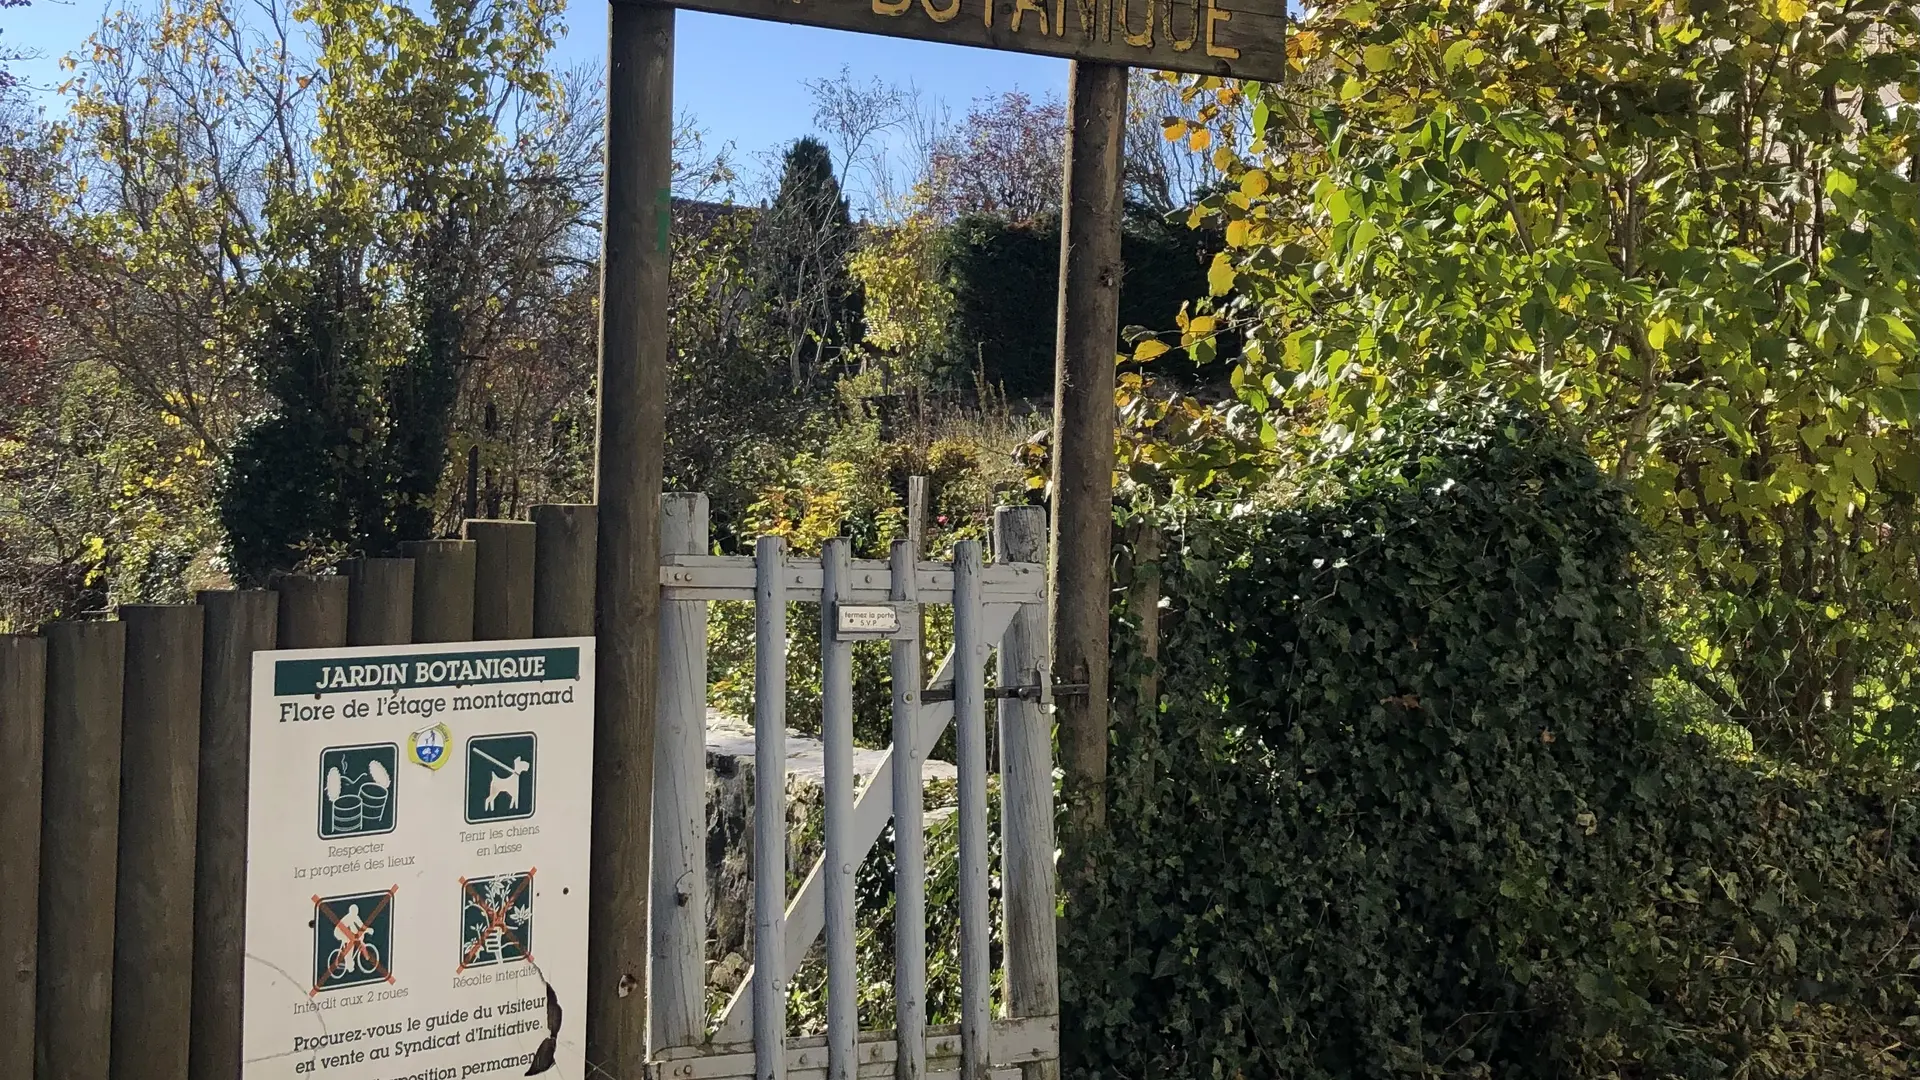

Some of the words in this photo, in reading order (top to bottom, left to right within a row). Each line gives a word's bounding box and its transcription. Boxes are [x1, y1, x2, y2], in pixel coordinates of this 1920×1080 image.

[877, 612, 894, 620] porte
[316, 663, 408, 690] JARDIN
[415, 656, 546, 684] BOTANIQUE
[279, 702, 335, 723] Flore
[342, 699, 370, 718] de
[376, 692, 446, 717] l'étage
[453, 686, 574, 712] montagnard
[459, 829, 488, 843] Tenir
[490, 828, 504, 839] les
[506, 824, 540, 837] chiens
[328, 842, 384, 858] Respecter
[476, 846, 490, 856] en
[494, 842, 522, 855] laisse
[294, 866, 306, 879] la
[309, 860, 361, 880] propreté
[364, 857, 385, 871] des
[388, 854, 416, 868] lieux
[452, 970, 492, 988] Récolte
[294, 993, 337, 1014] Interdit
[340, 994, 364, 1006] aux
[367, 990, 376, 1003] 2
[378, 987, 409, 1002] roues
[294, 1020, 402, 1051] Procurez-vous
[407, 1018, 420, 1032] le
[426, 1010, 468, 1032] guide
[474, 1004, 492, 1020] du
[498, 996, 546, 1016] visiteur
[296, 1058, 316, 1074] en
[321, 1052, 364, 1070] vente
[370, 1046, 390, 1060] au
[394, 1030, 461, 1057] Syndicat
[466, 1018, 543, 1042] d'Initiative.
